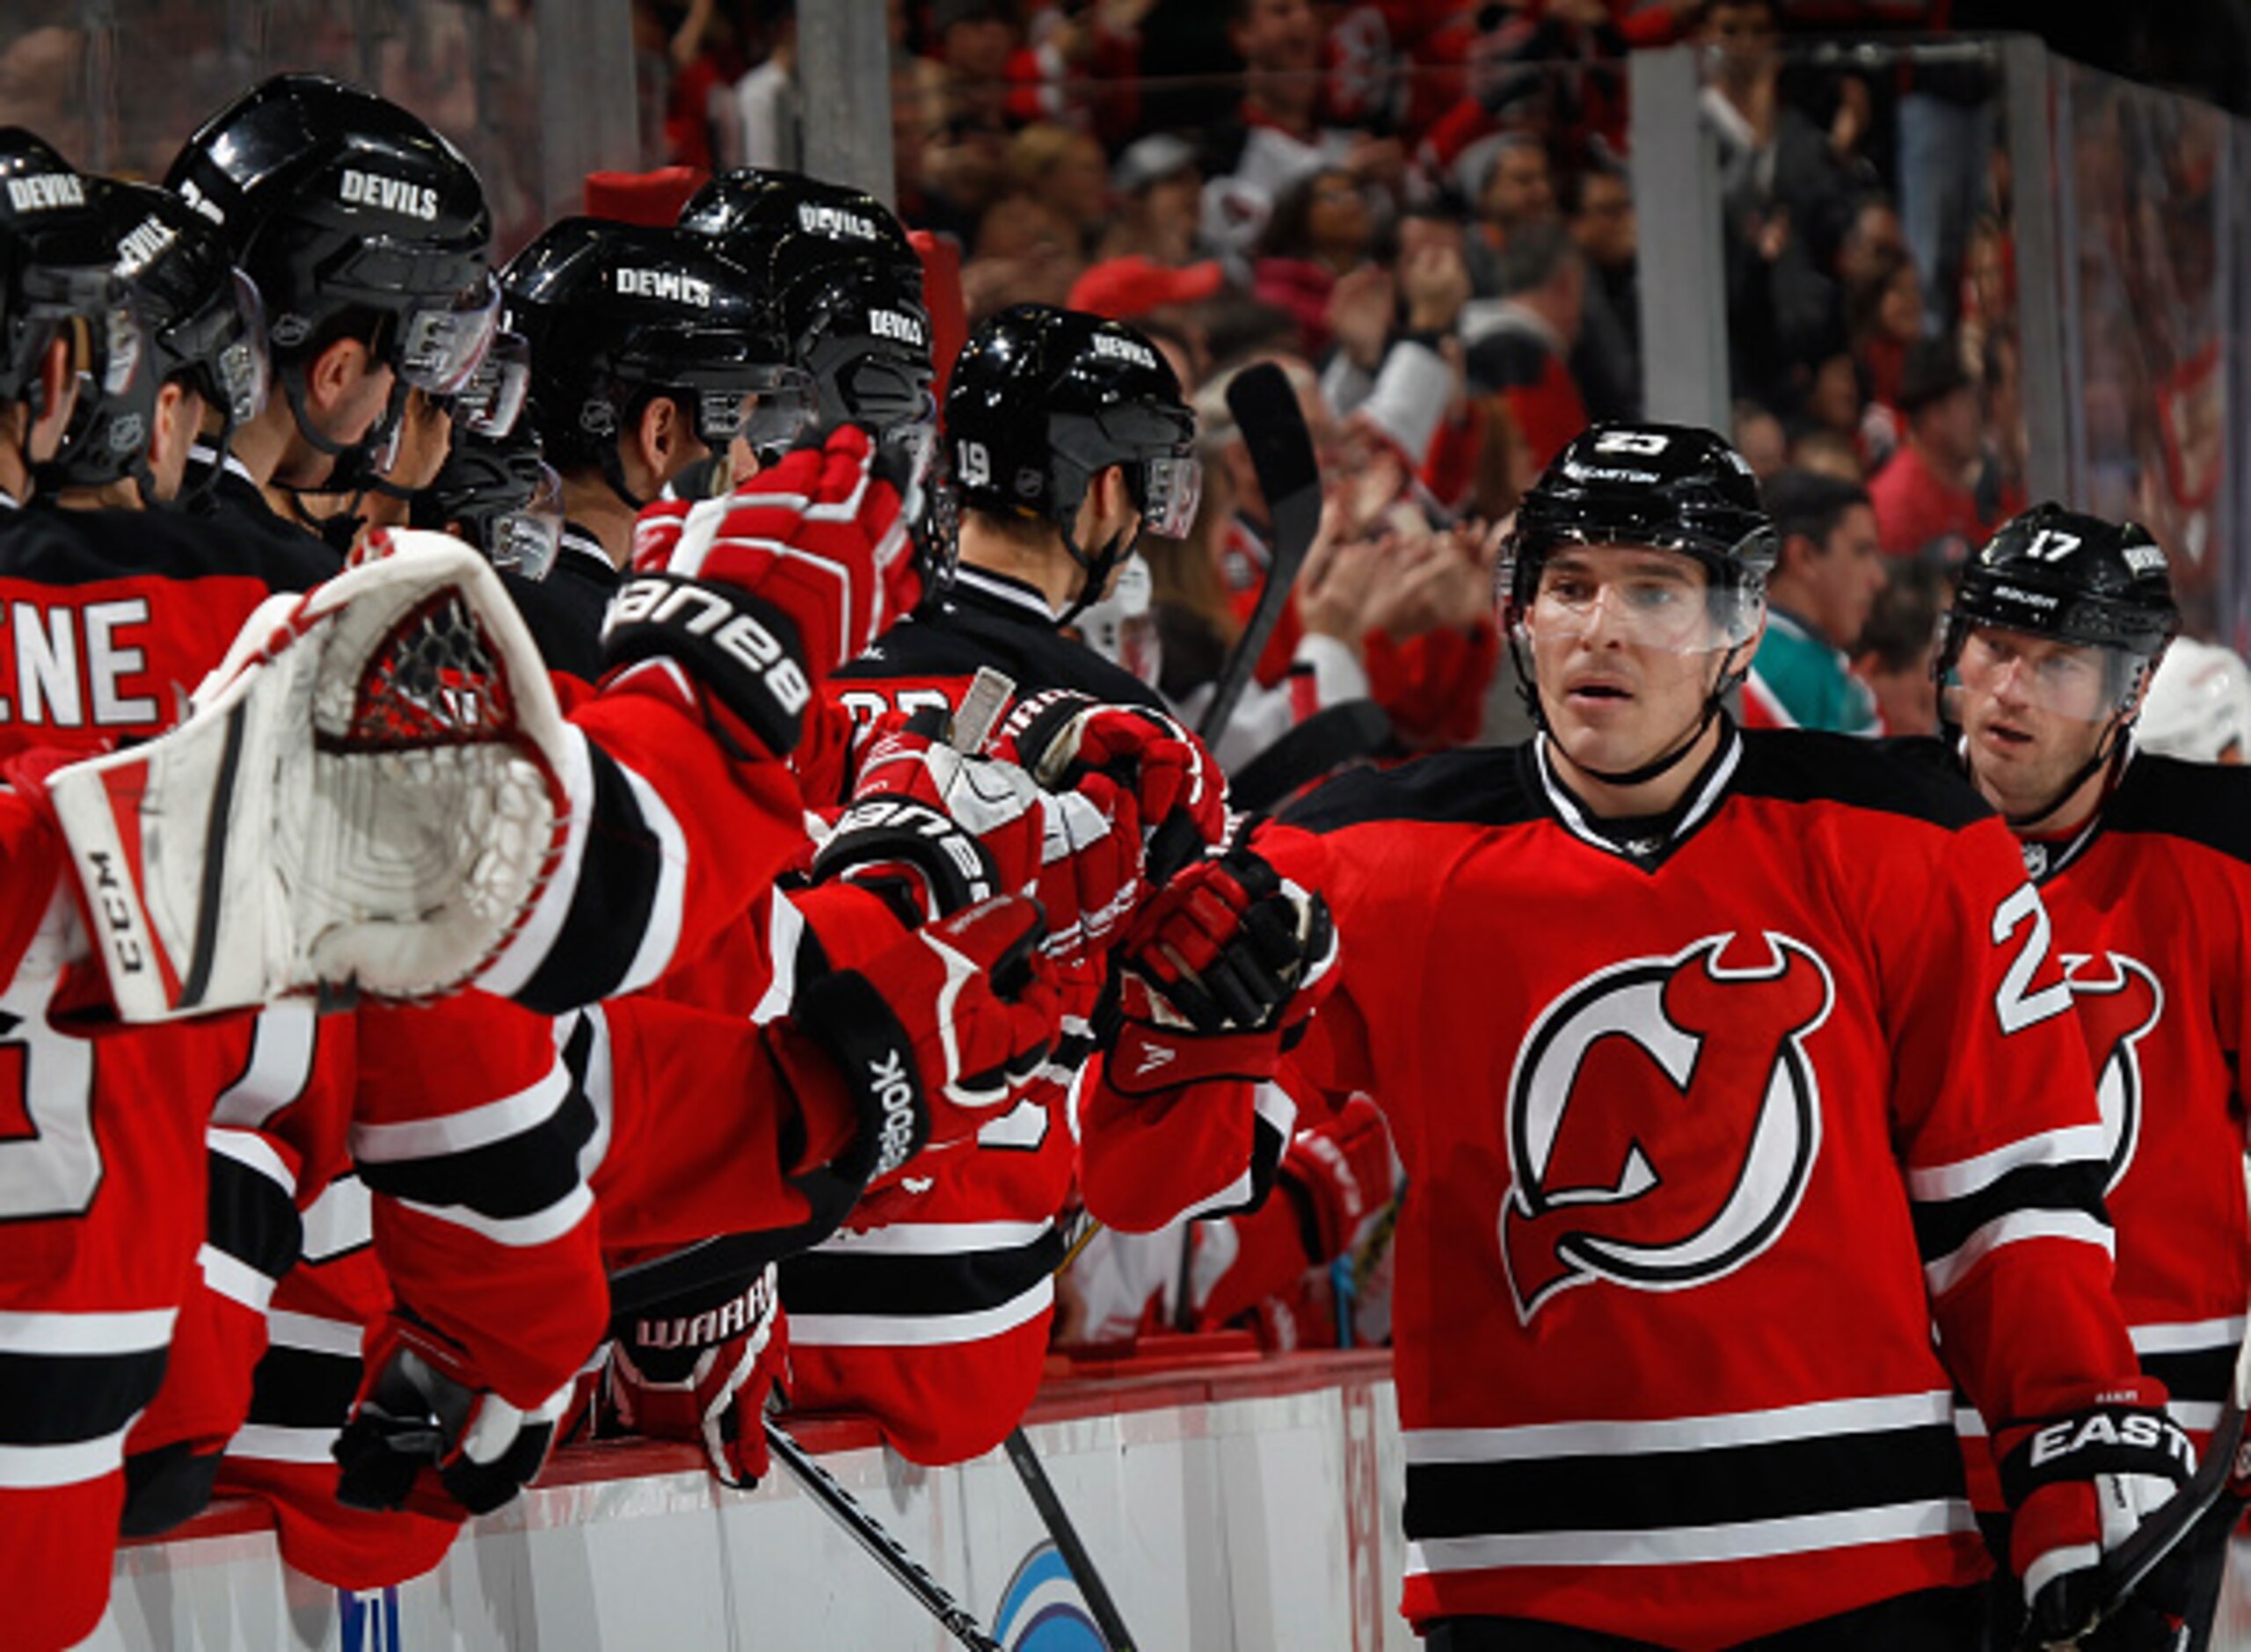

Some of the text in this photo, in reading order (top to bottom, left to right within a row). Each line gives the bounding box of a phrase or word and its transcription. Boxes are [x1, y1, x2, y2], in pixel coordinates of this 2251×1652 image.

[340, 169, 439, 222] DEVILS
[957, 440, 990, 487] 19
[2026, 529, 2081, 562] 17
[0, 598, 158, 728] NE
[88, 851, 144, 973] CCM
[1991, 879, 2073, 1035] 2
